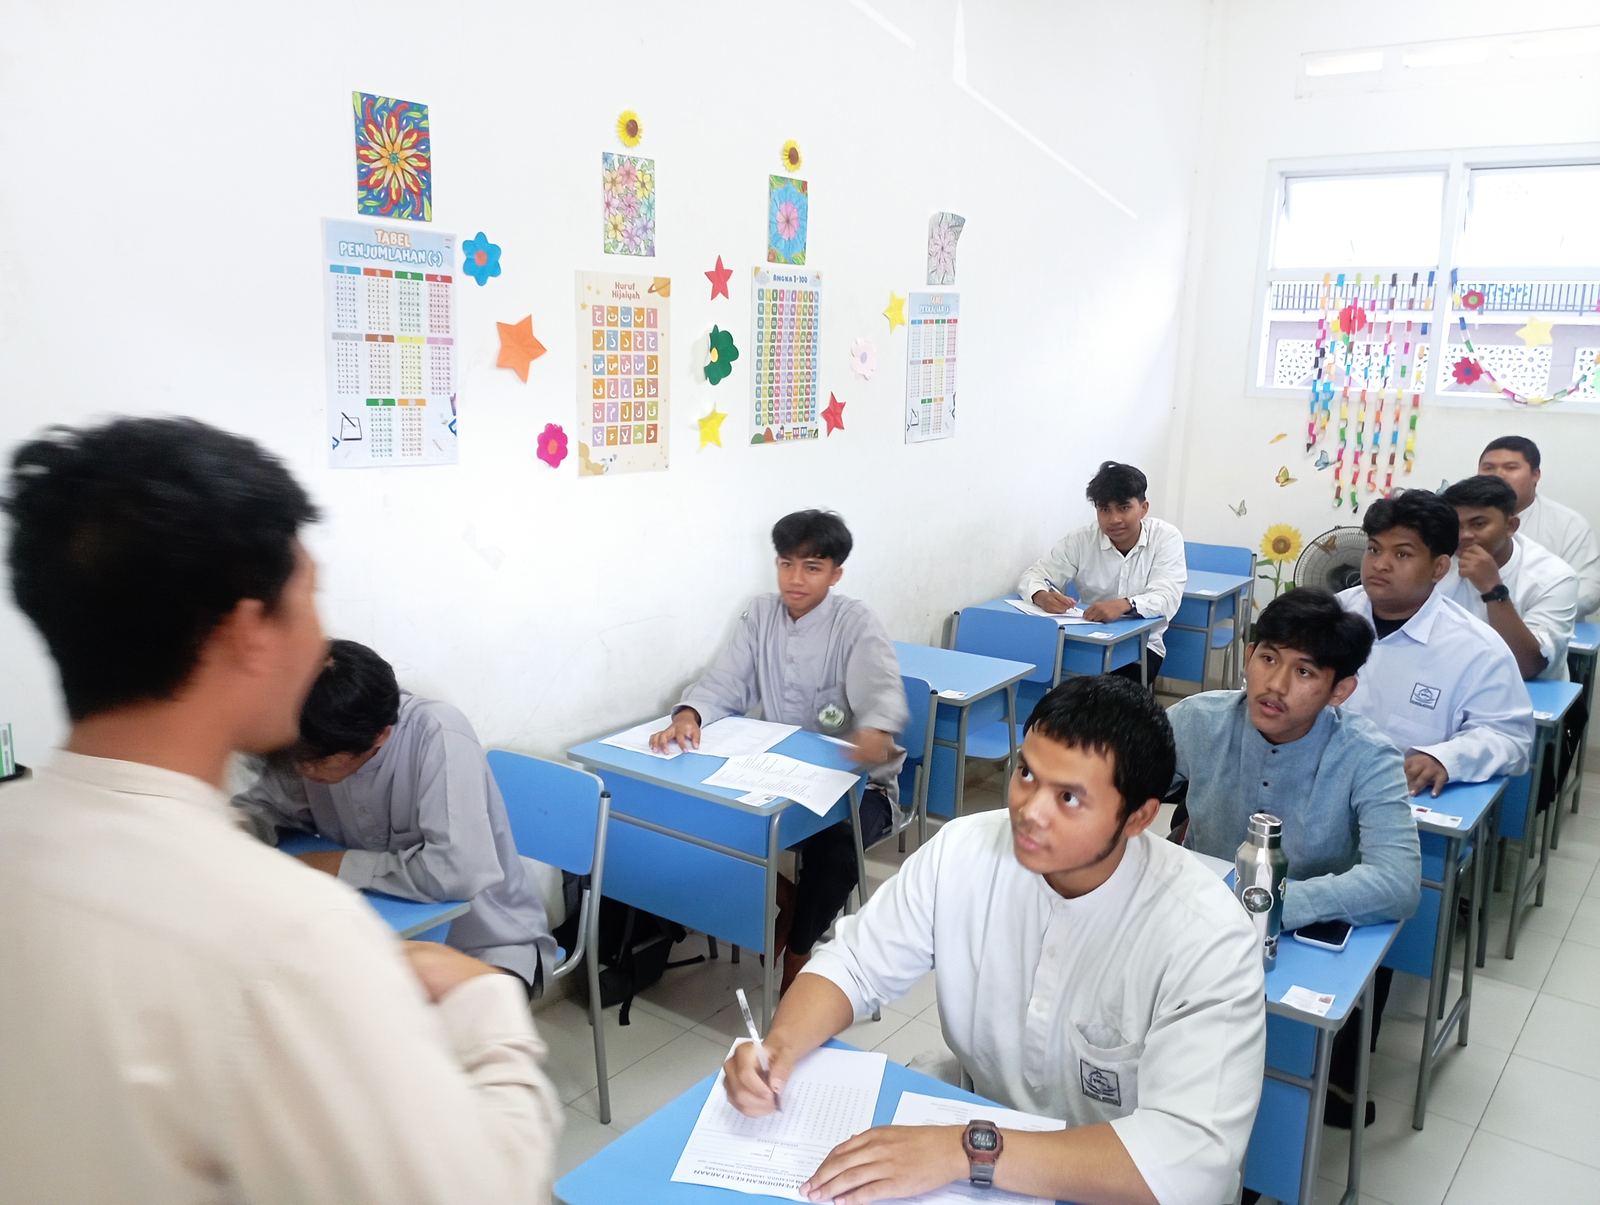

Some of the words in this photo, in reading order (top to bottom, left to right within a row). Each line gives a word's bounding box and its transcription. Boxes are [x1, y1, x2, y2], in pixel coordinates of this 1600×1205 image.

[375, 229, 412, 247] TABEL
[339, 241, 426, 263] PENJUMLAHAN
[773, 274, 793, 282] ANGKA
[615, 281, 635, 291] Huruf
[612, 290, 640, 301] Hijaiyah
[693, 1169, 745, 1182] KESETARAAN
[745, 1178, 795, 1190] PENDIDIKAN
